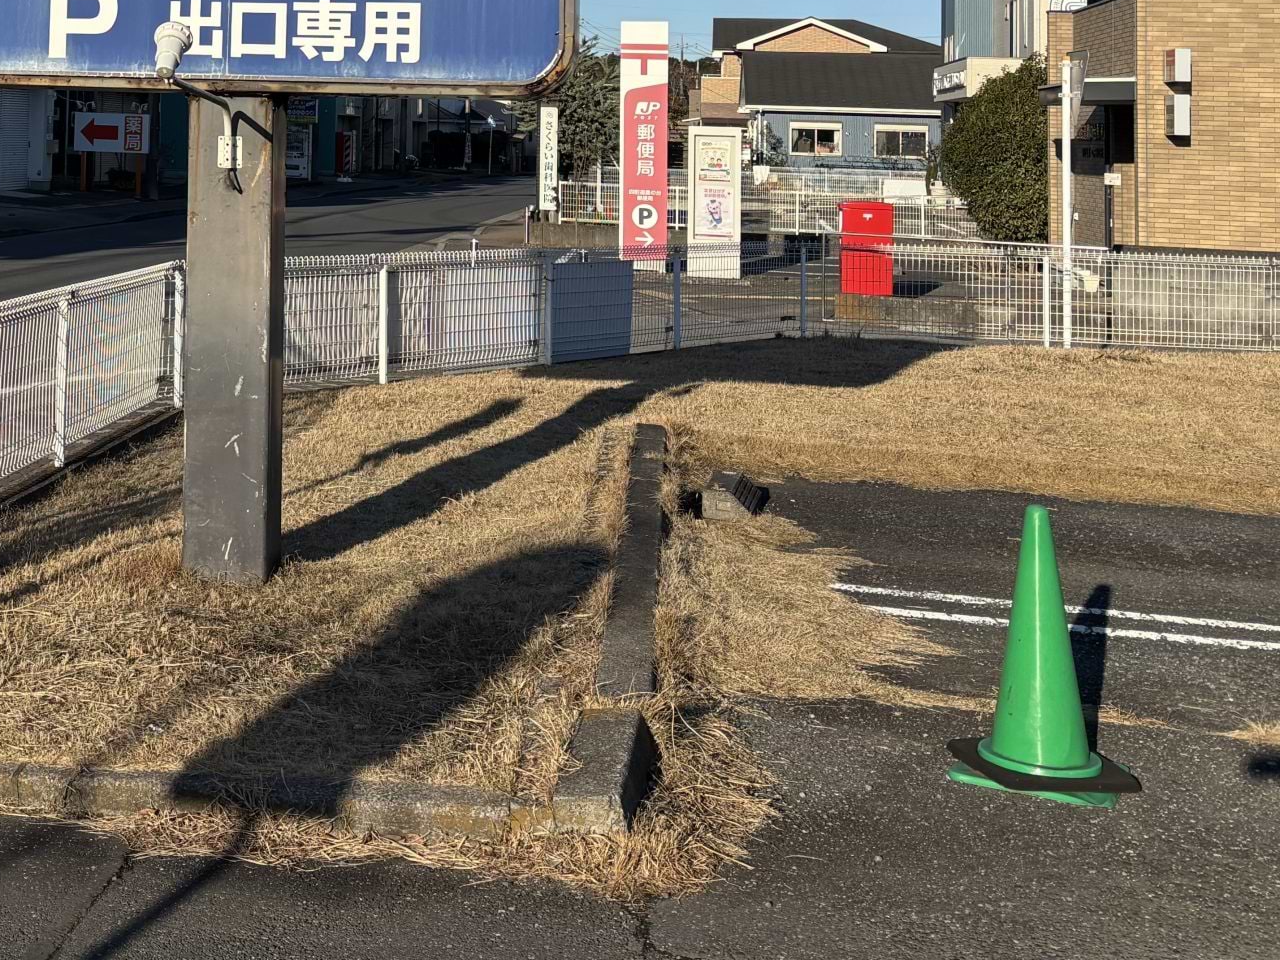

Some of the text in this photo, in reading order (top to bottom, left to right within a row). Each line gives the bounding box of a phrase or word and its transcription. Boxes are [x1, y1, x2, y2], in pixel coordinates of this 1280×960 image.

[125, 116, 142, 151] 薬局
[636, 123, 655, 177] 郵便局
[639, 207, 653, 225] P
